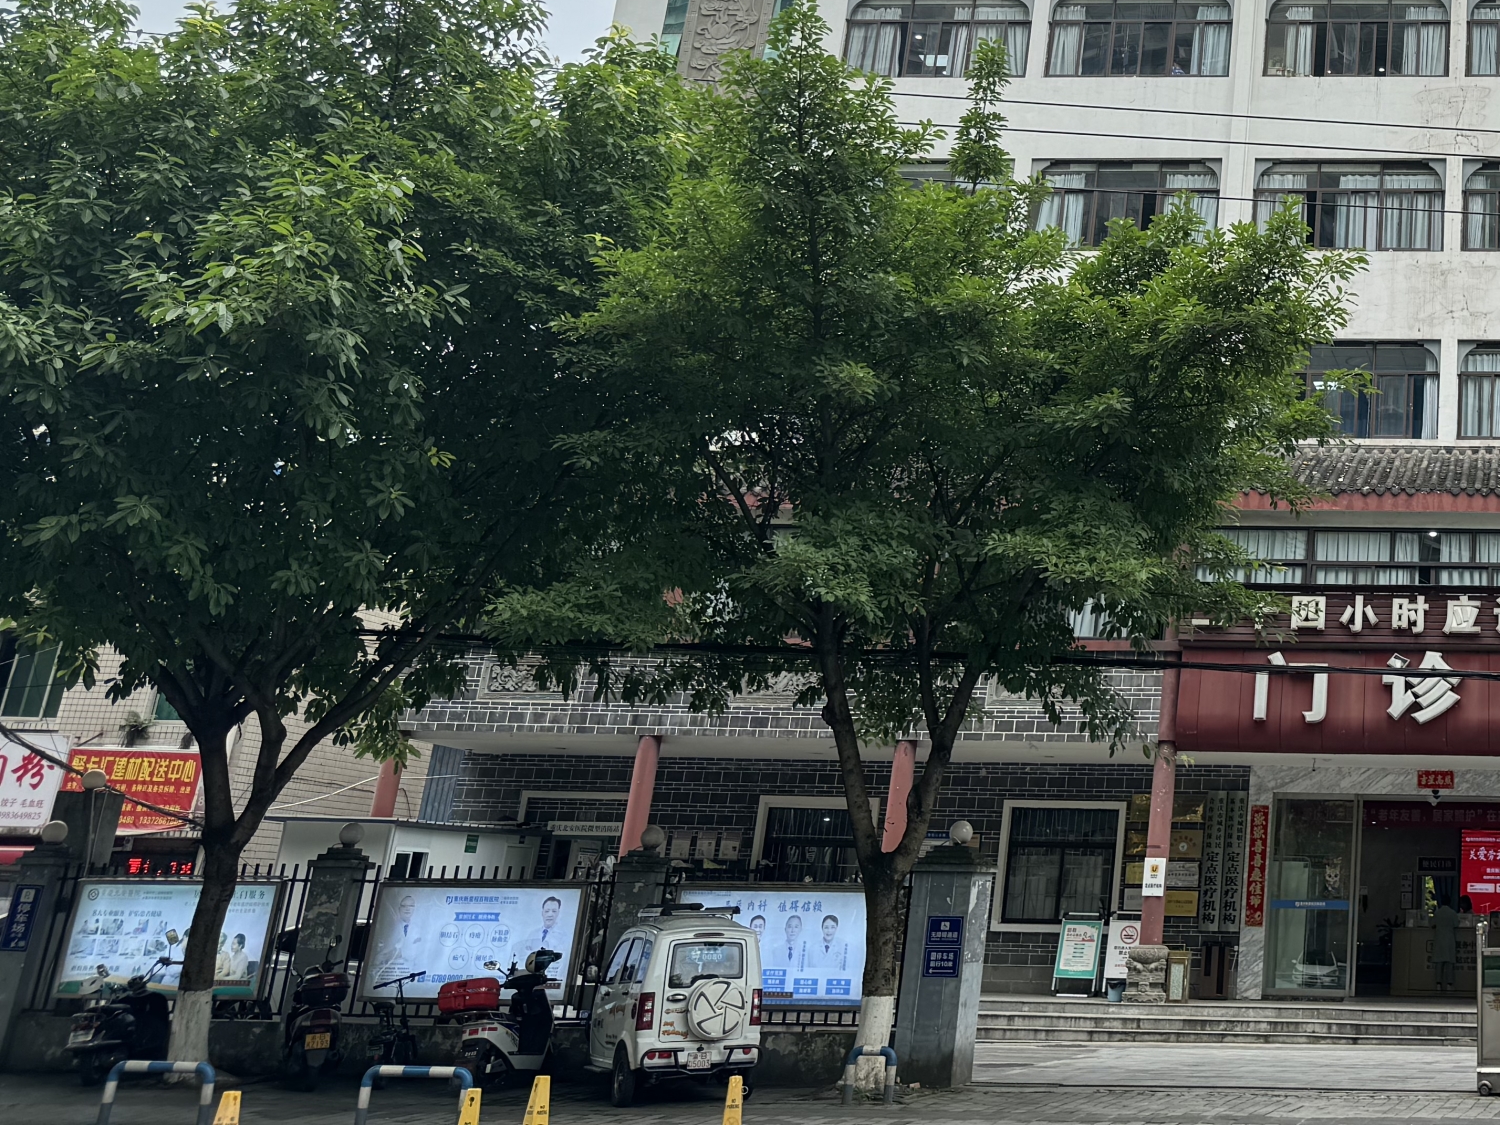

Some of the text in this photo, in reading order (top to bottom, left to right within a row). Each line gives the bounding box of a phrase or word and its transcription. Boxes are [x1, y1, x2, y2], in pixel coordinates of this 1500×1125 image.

[778, 899, 823, 913] 值得信赖
[1202, 851, 1219, 925] 定点医疗机构
[1223, 851, 1240, 925] 定点医疗机构
